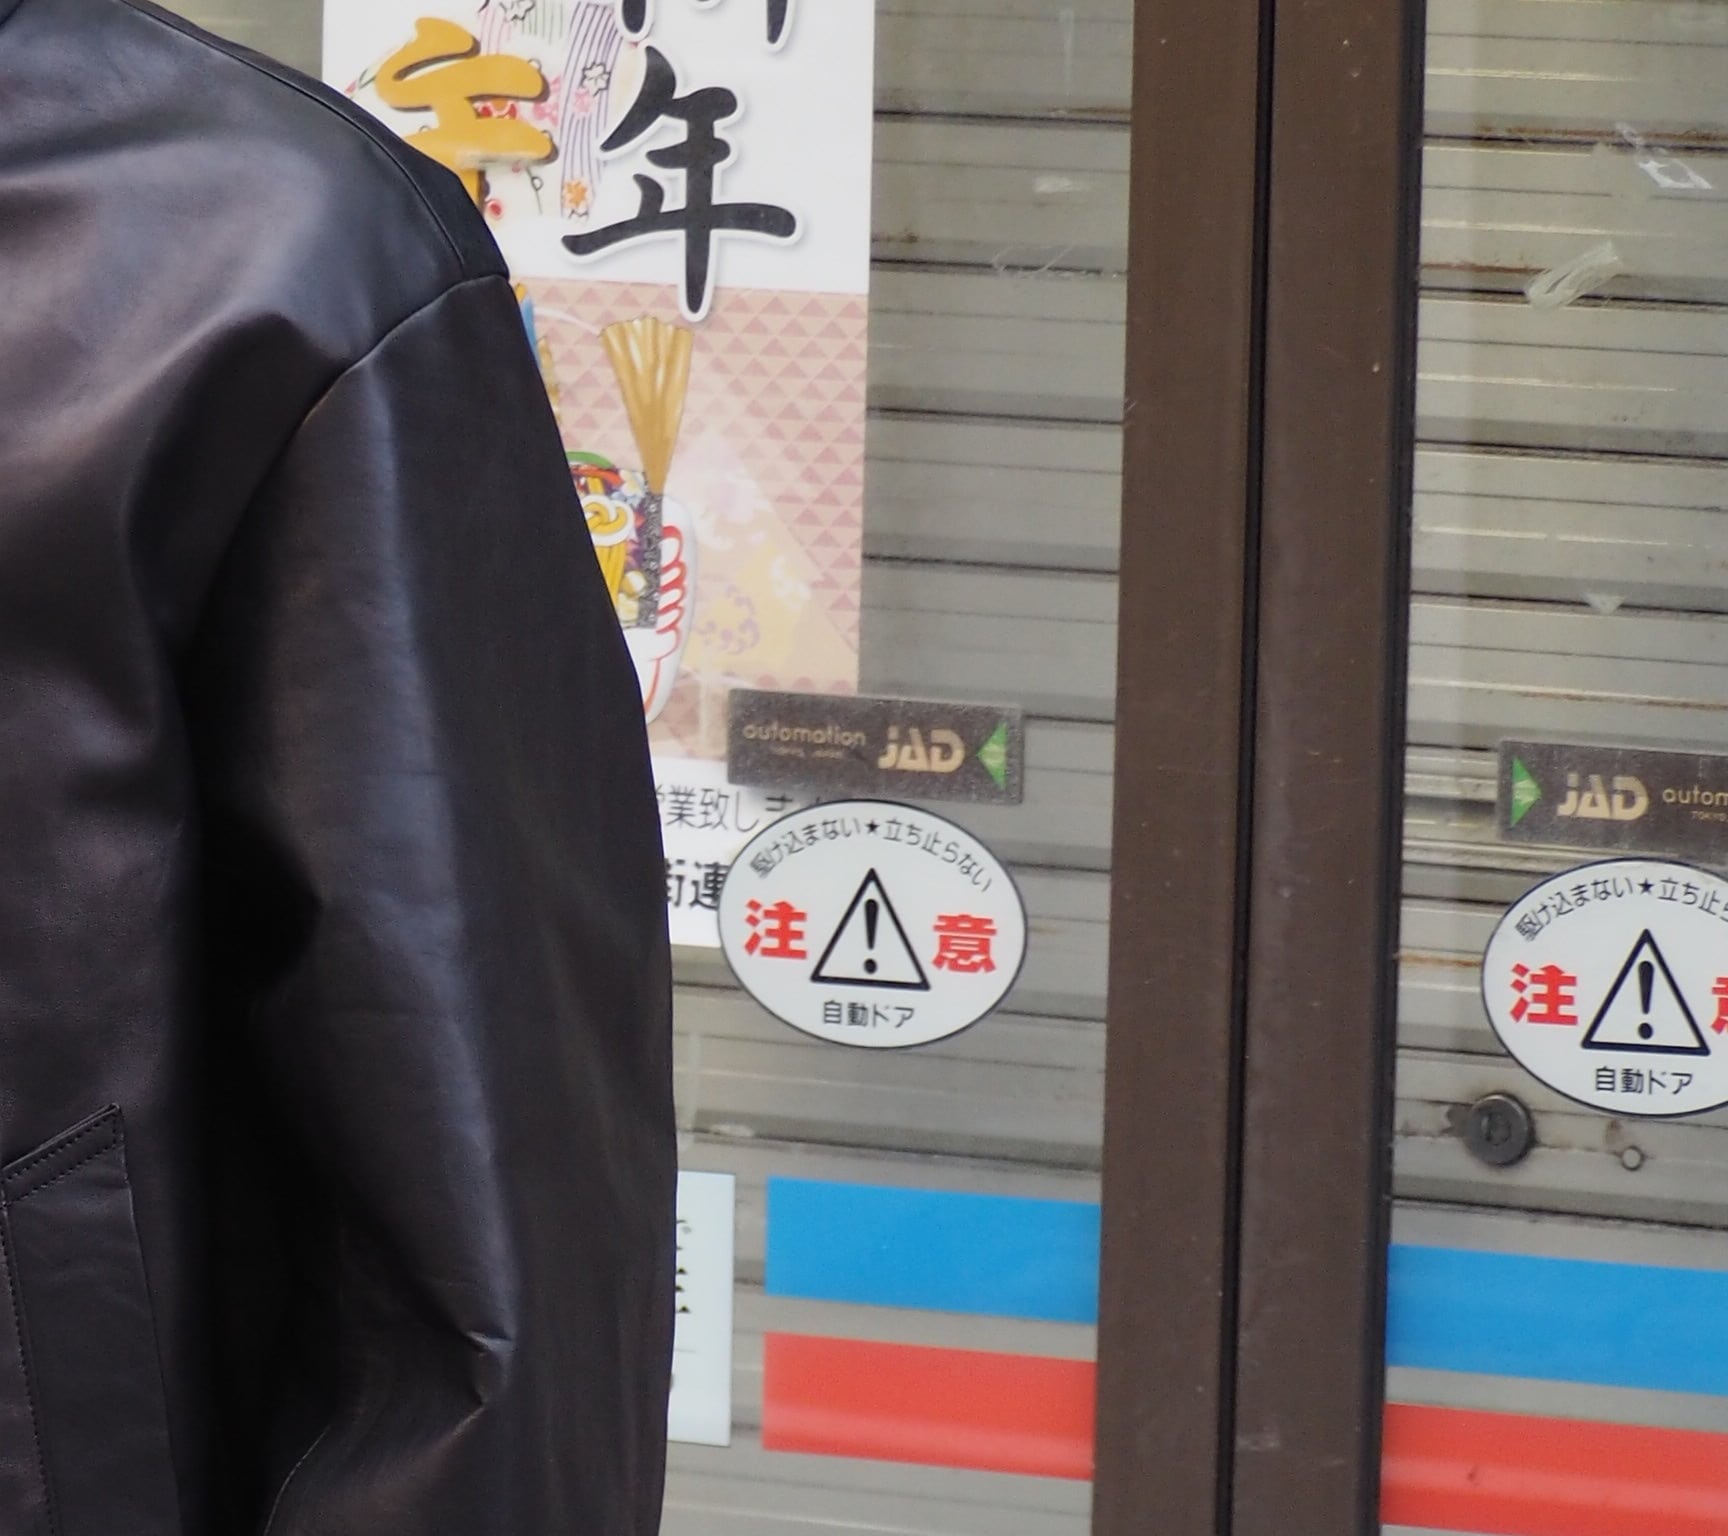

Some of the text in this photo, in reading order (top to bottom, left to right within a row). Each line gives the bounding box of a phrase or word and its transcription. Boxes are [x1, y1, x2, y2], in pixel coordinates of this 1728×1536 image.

[743, 722, 866, 746] automation
[1510, 963, 1579, 1026] 注
[823, 1000, 914, 1029] 自動ドア
[1595, 1066, 1693, 1096] 自動ドア
